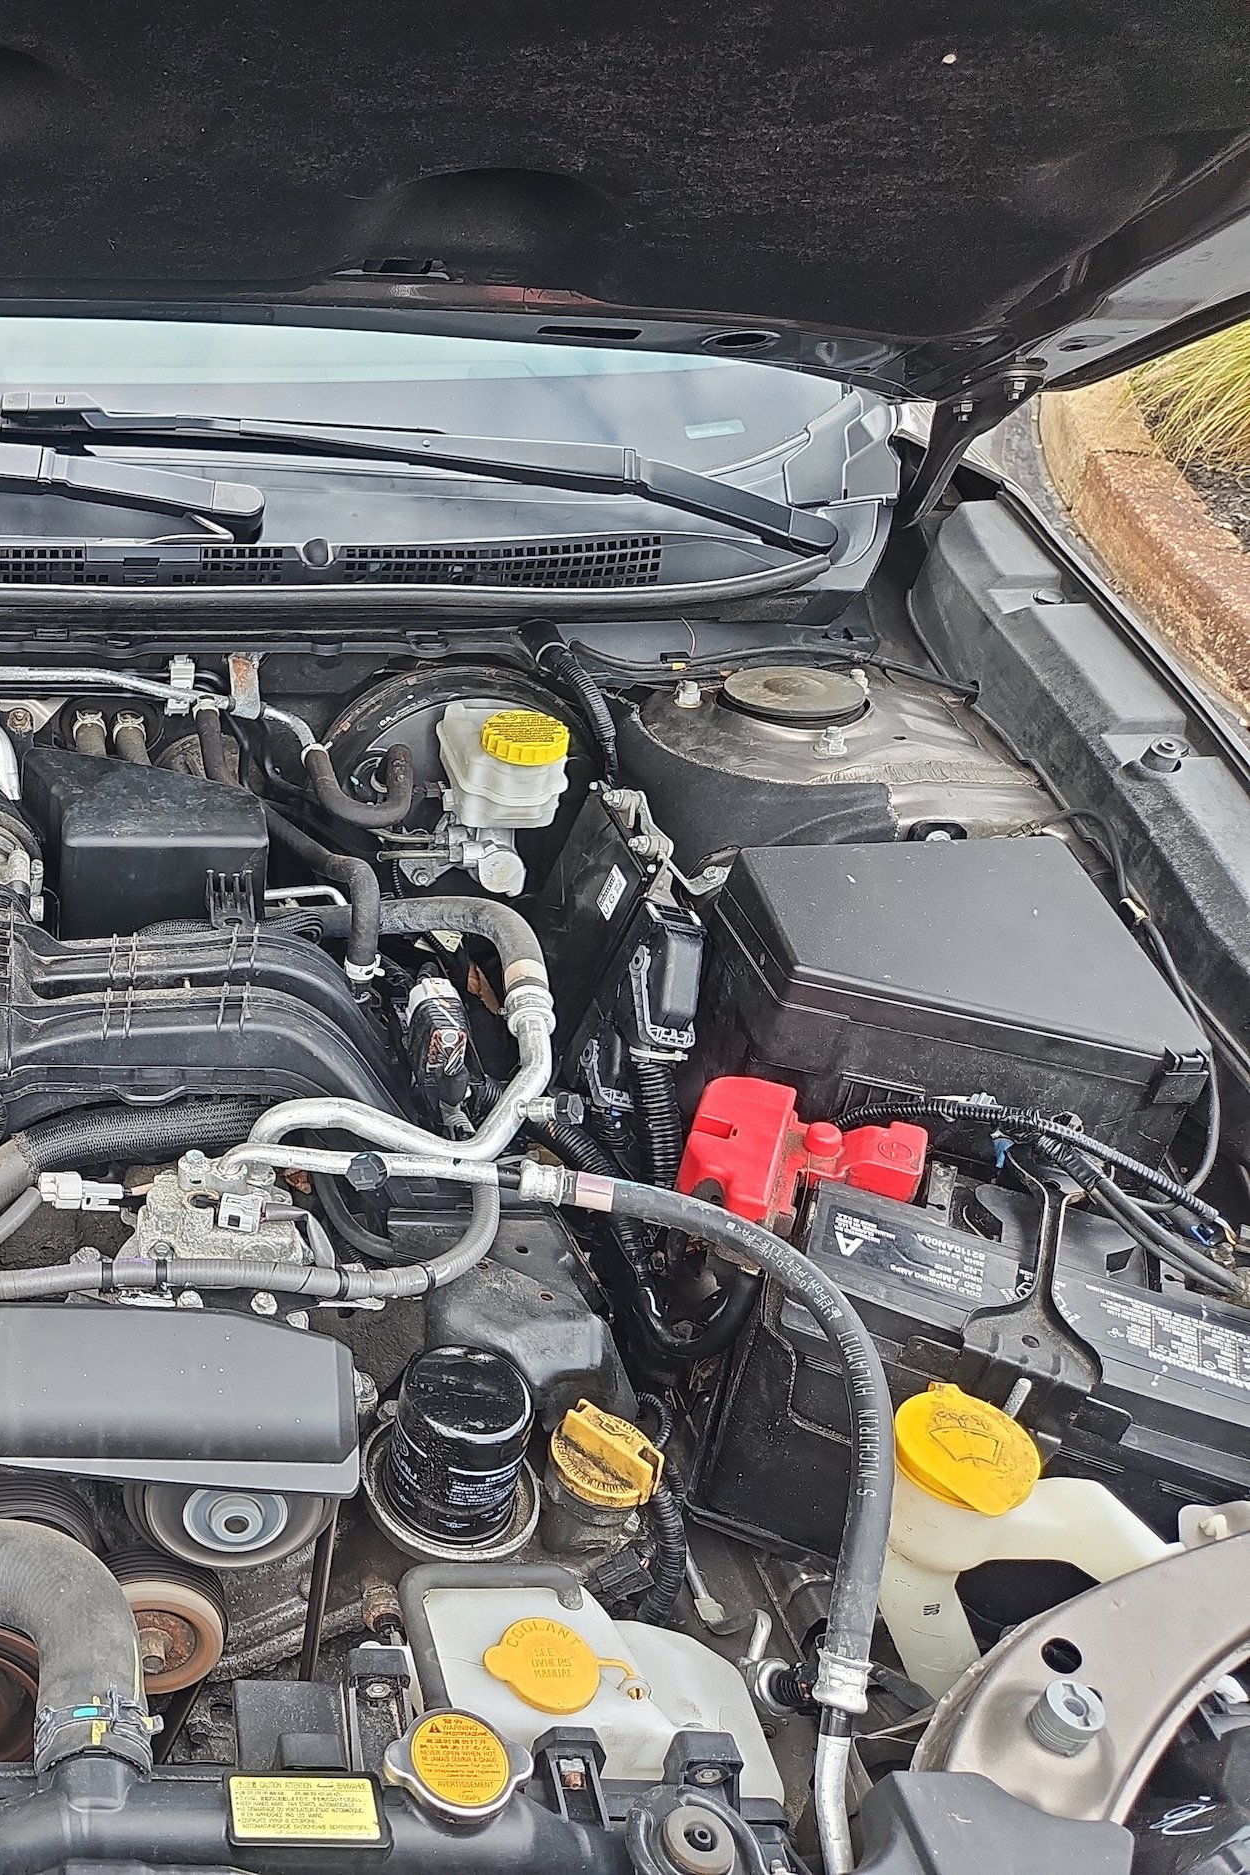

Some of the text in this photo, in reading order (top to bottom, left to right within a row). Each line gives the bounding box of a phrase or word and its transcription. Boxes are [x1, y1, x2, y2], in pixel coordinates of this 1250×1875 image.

[889, 1263, 913, 1277] AMPS
[927, 1268, 959, 1284] AMPS
[963, 1264, 983, 1276] LN2
[953, 1270, 983, 1283] GROUP
[958, 1286, 981, 1298] COLD
[506, 1620, 581, 1648] COOLANT
[285, 1781, 312, 1789] ATTENTION
[437, 1780, 494, 1788] AVERTISSEMENT
